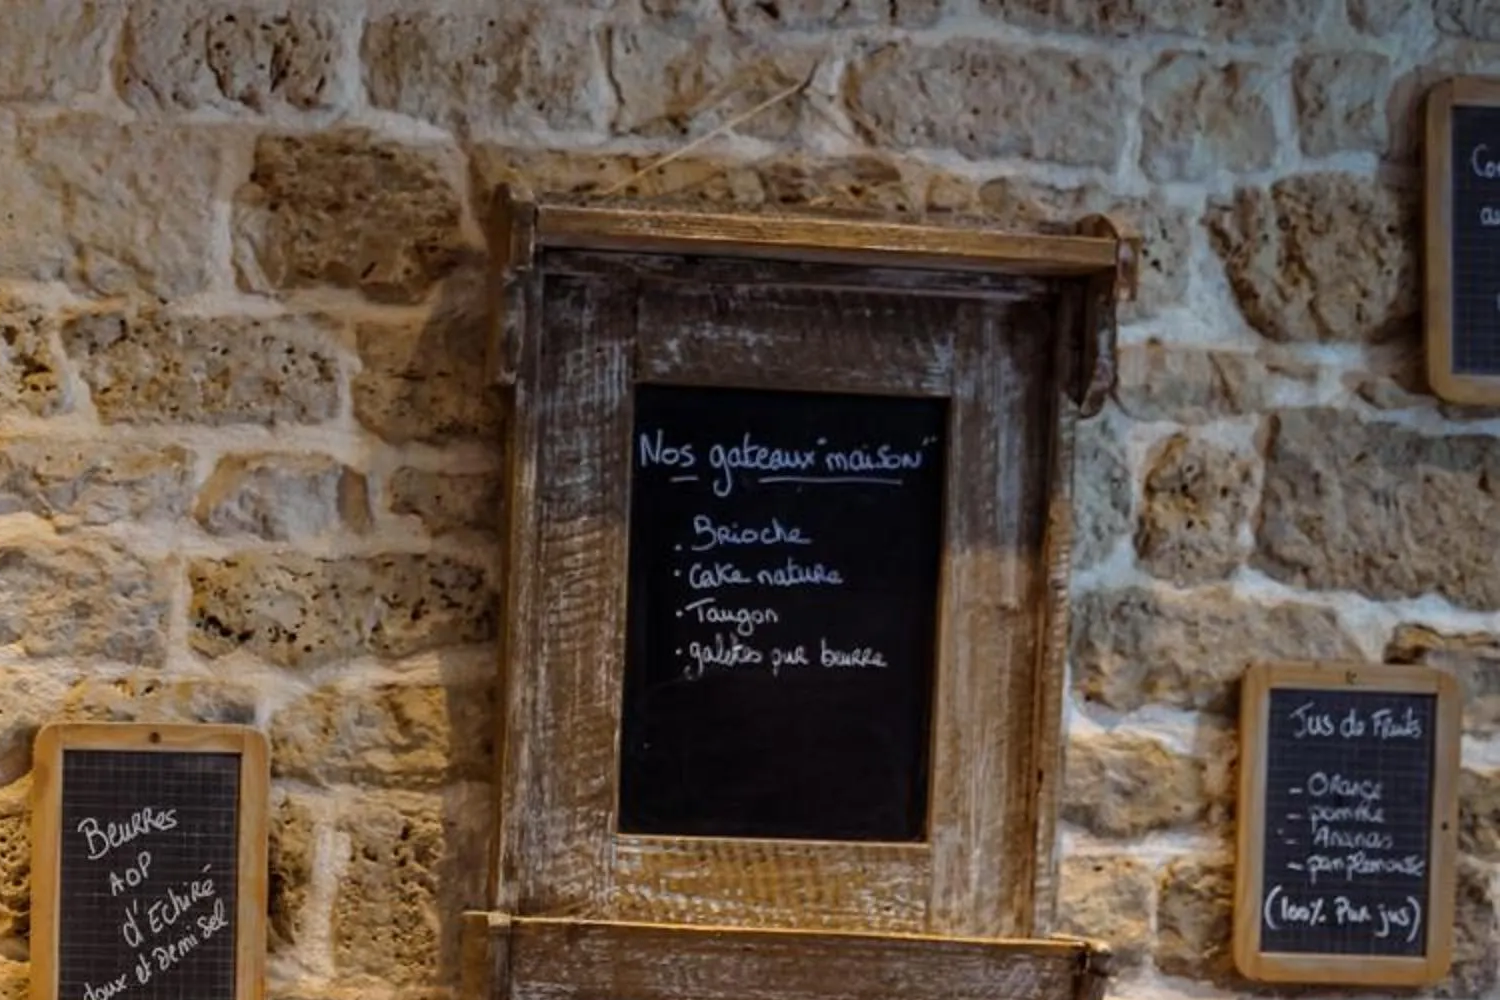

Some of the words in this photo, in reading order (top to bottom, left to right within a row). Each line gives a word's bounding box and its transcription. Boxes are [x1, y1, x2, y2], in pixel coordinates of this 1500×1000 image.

[639, 429, 697, 468] Nos
[708, 432, 816, 498] gateaux
[691, 514, 813, 552] Brioche
[689, 561, 754, 590] Cake
[756, 555, 845, 587] nature
[772, 645, 810, 678] pur
[820, 636, 888, 668] beurre
[1289, 701, 1336, 739] Jus
[1339, 707, 1366, 739] de
[1370, 706, 1424, 740] Fruits
[1306, 771, 1383, 801] Orange
[77, 807, 178, 860] Beurres
[109, 851, 152, 897] AOP
[134, 952, 154, 985] et
